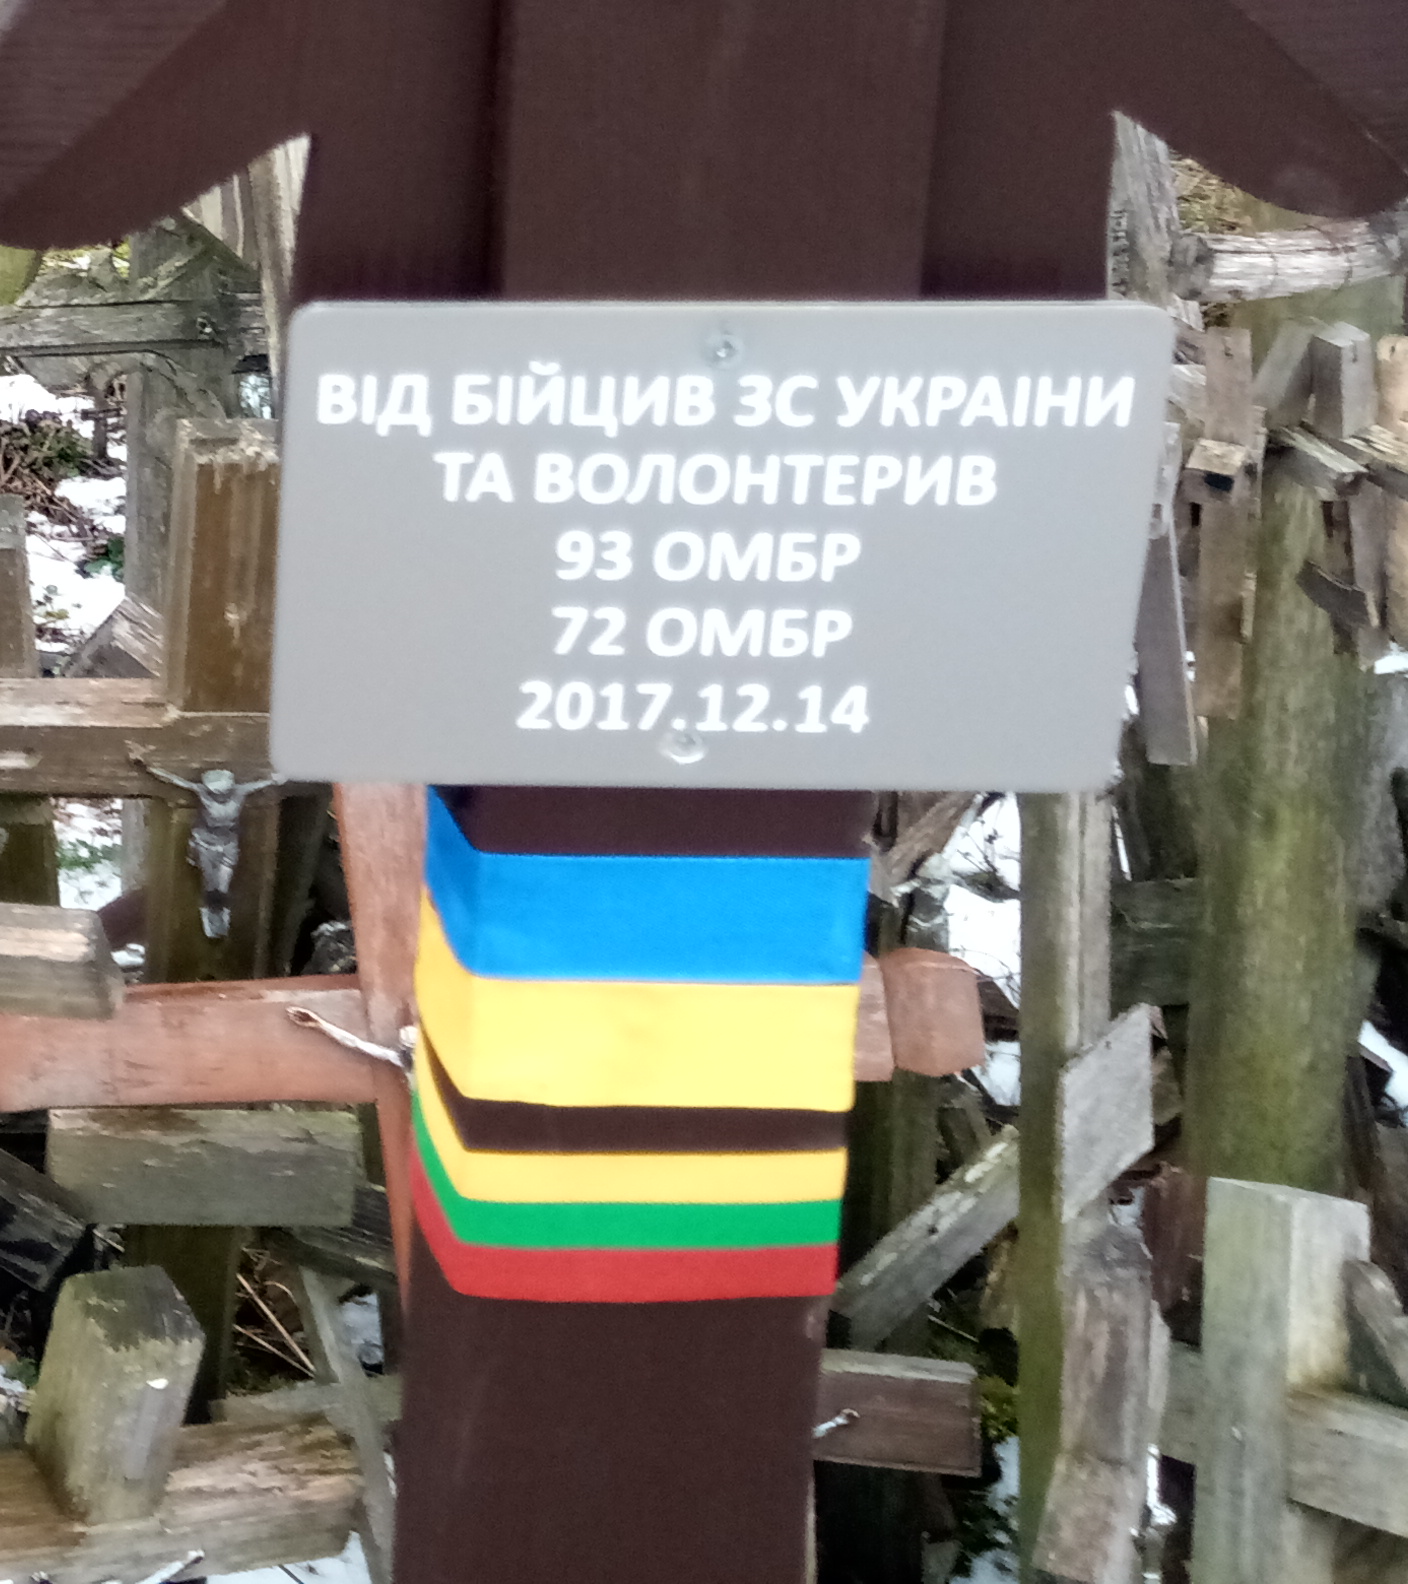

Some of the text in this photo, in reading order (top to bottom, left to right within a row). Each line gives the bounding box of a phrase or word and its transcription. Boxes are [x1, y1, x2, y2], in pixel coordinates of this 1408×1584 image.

[317, 360, 1136, 438] ВІД БІЙЦИВ ЗС УКРАІНИ
[433, 450, 997, 506] ТА ВОЛОНТЕРИВ
[555, 529, 862, 583] 93 ОМБР
[552, 605, 853, 658] 72 ОМБР
[516, 679, 870, 734] 2017.12.14
